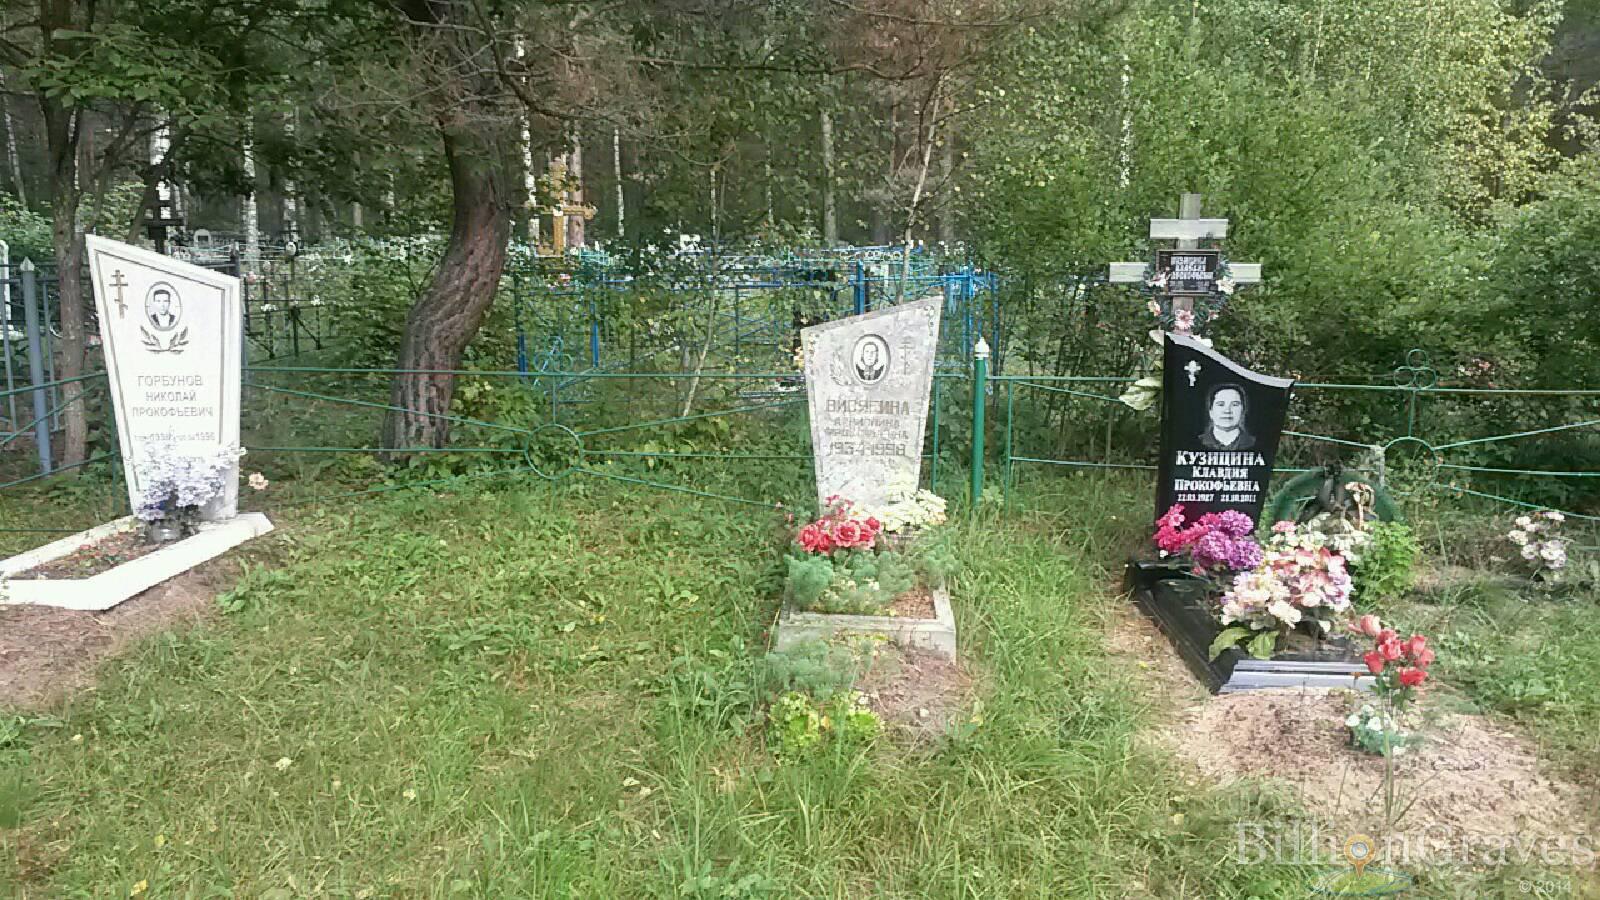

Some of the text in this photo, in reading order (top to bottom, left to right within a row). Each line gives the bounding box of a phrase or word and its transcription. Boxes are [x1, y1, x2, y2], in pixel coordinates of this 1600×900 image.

[137, 375, 204, 387] ГОРБУНОВ
[145, 390, 197, 402] НИКОЛАЙ
[132, 406, 214, 417] ПРОКОФЬЕВИЧ
[1192, 466, 1250, 480] КЛАВДИЯ
[1174, 478, 1261, 492] ПРОКОФЬЕВНА
